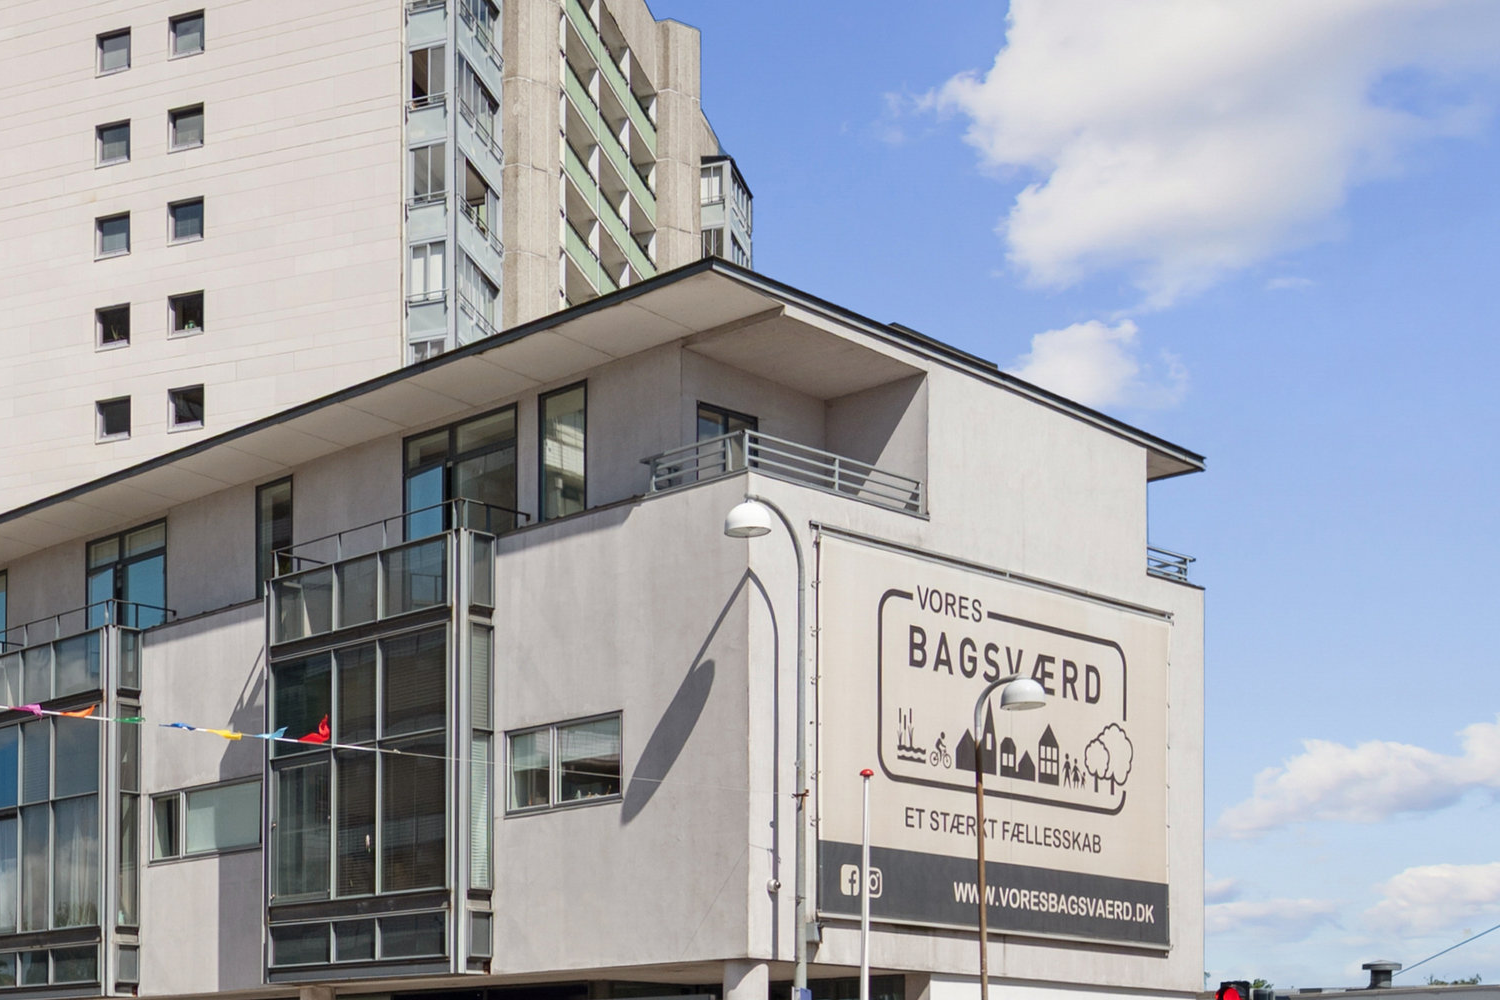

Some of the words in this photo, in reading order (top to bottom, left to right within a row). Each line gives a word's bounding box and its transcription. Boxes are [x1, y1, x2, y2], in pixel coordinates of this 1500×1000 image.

[917, 585, 983, 623] VORES
[908, 624, 1102, 705] BAGSVÆRD
[904, 806, 925, 830] ET
[1002, 820, 1102, 854] FÆLLESSKAB
[953, 881, 1155, 924] WWW.VORESBAGSVAERD.DK
